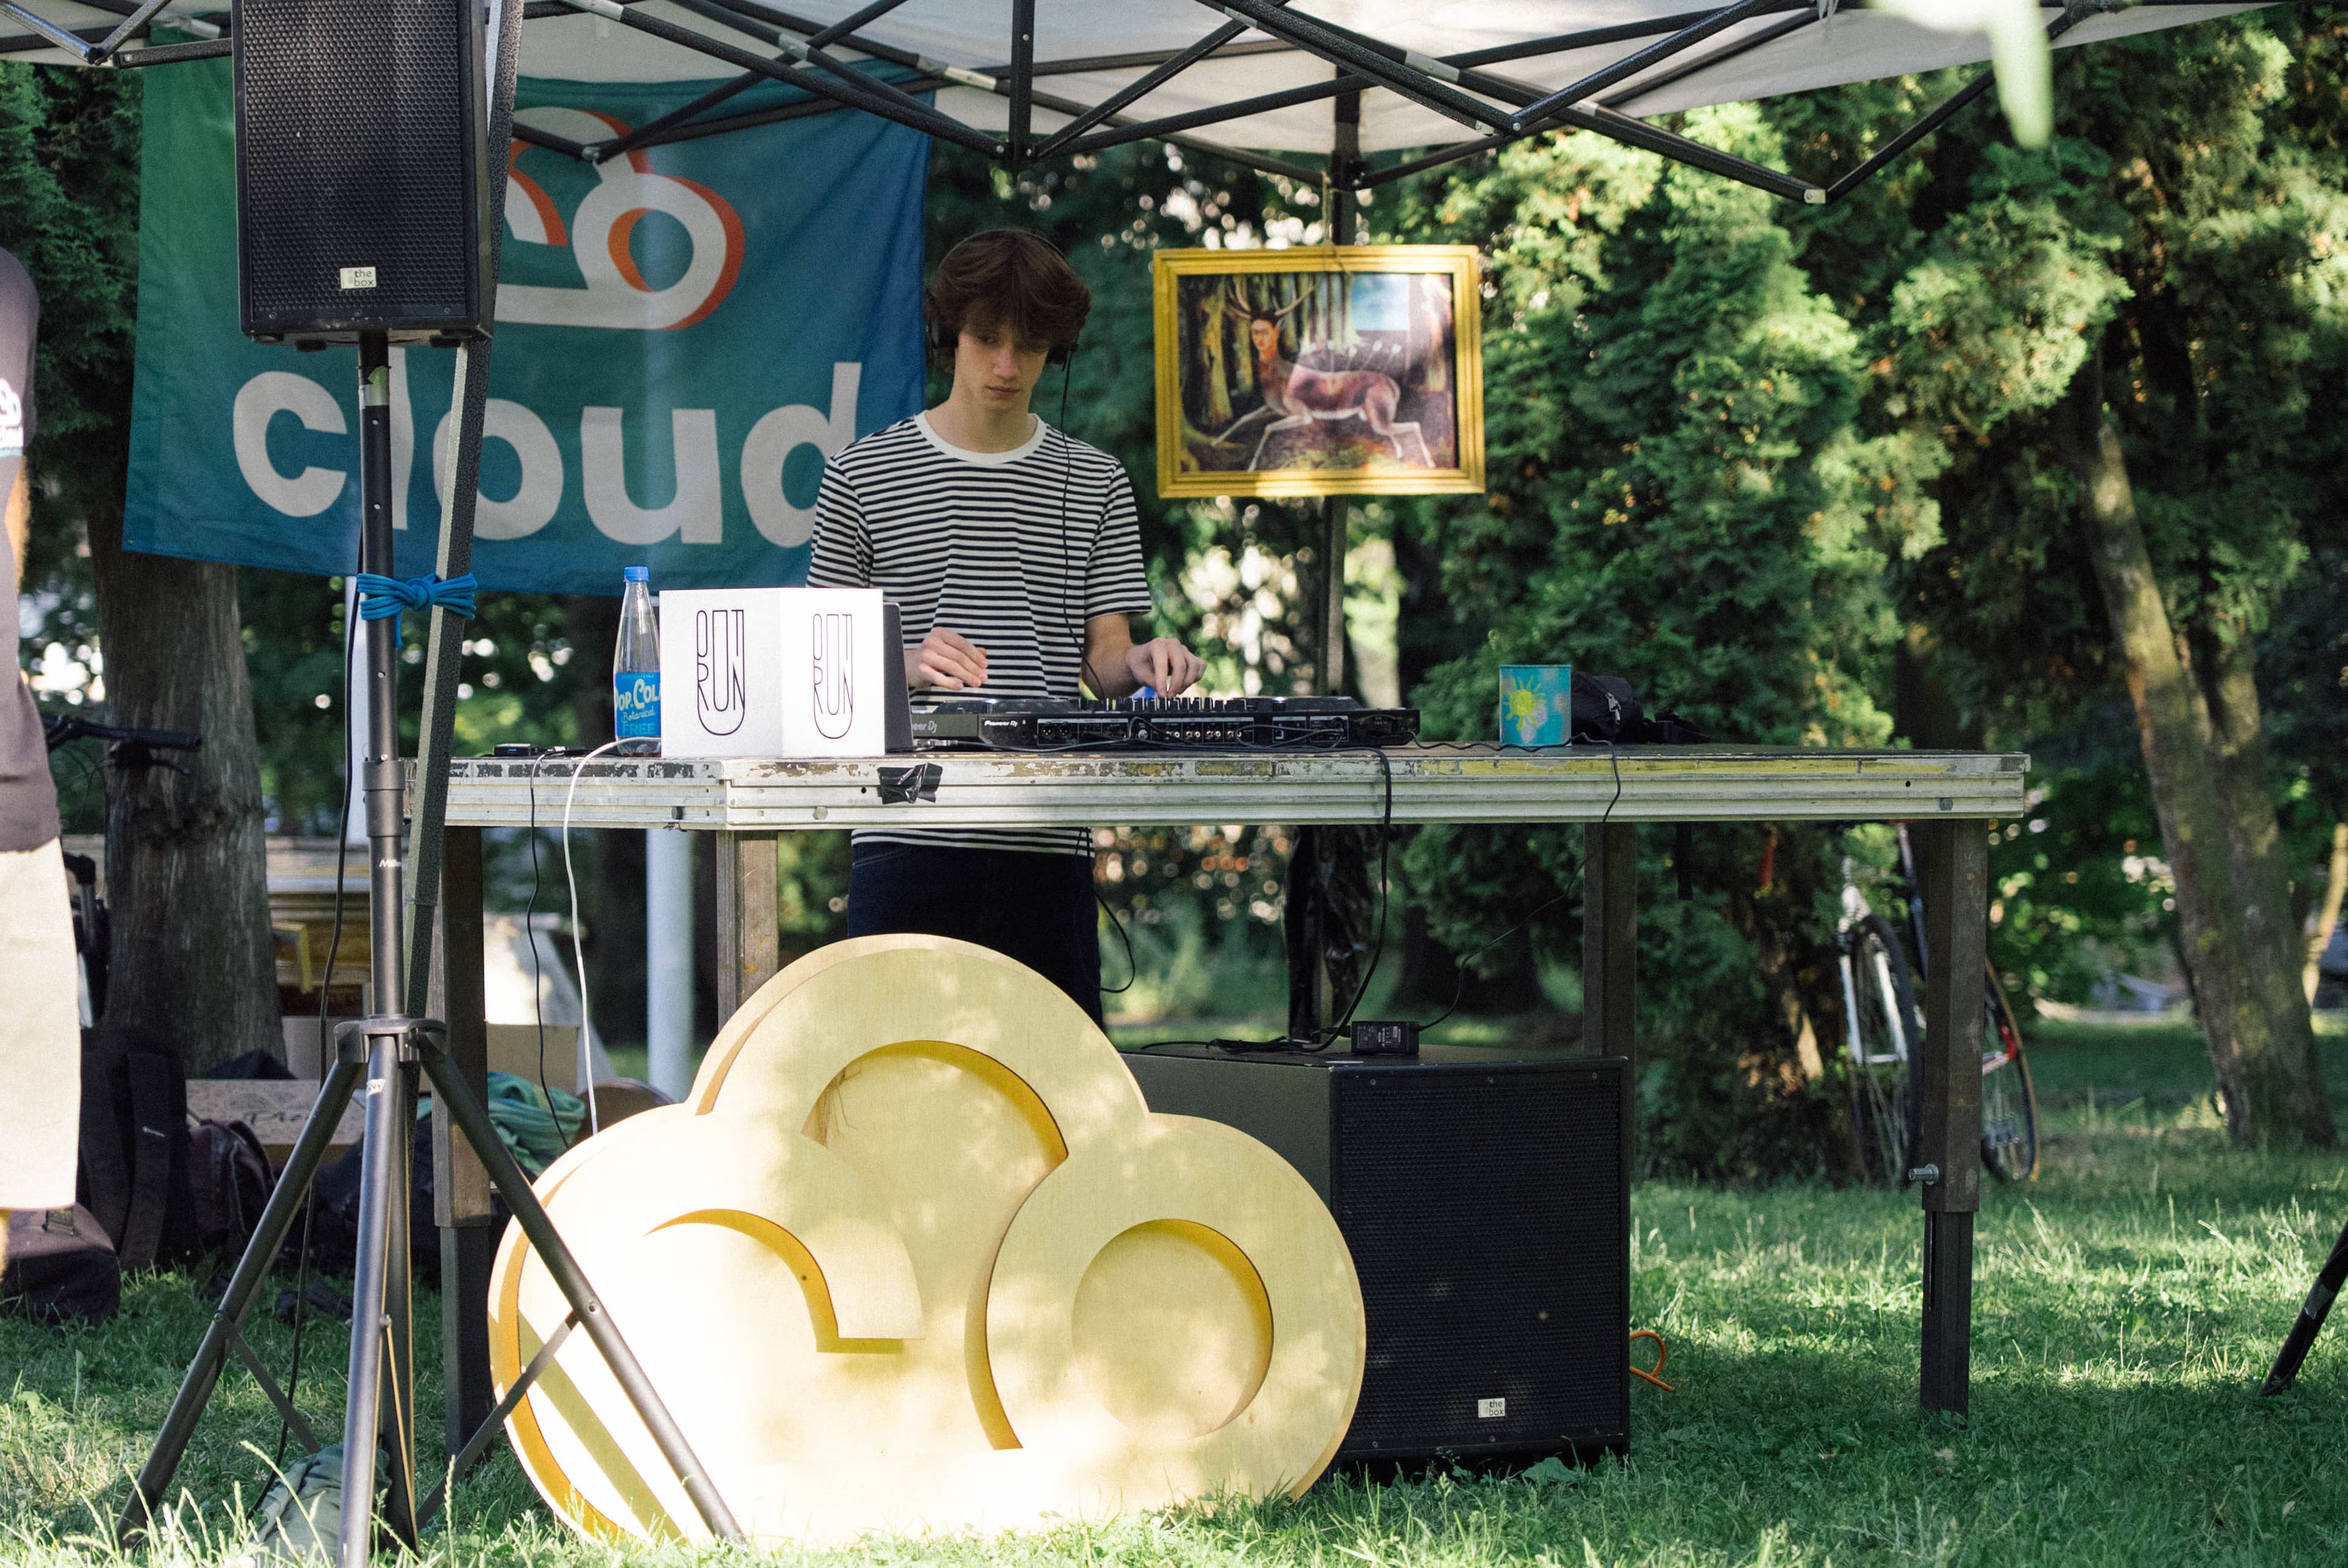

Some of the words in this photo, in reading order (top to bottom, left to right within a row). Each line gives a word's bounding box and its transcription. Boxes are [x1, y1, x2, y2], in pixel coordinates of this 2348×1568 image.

[355, 269, 372, 278] the
[354, 278, 374, 287] box
[233, 347, 862, 547] cloud
[622, 723, 655, 736] FREE
[1489, 1408, 1504, 1416] box
